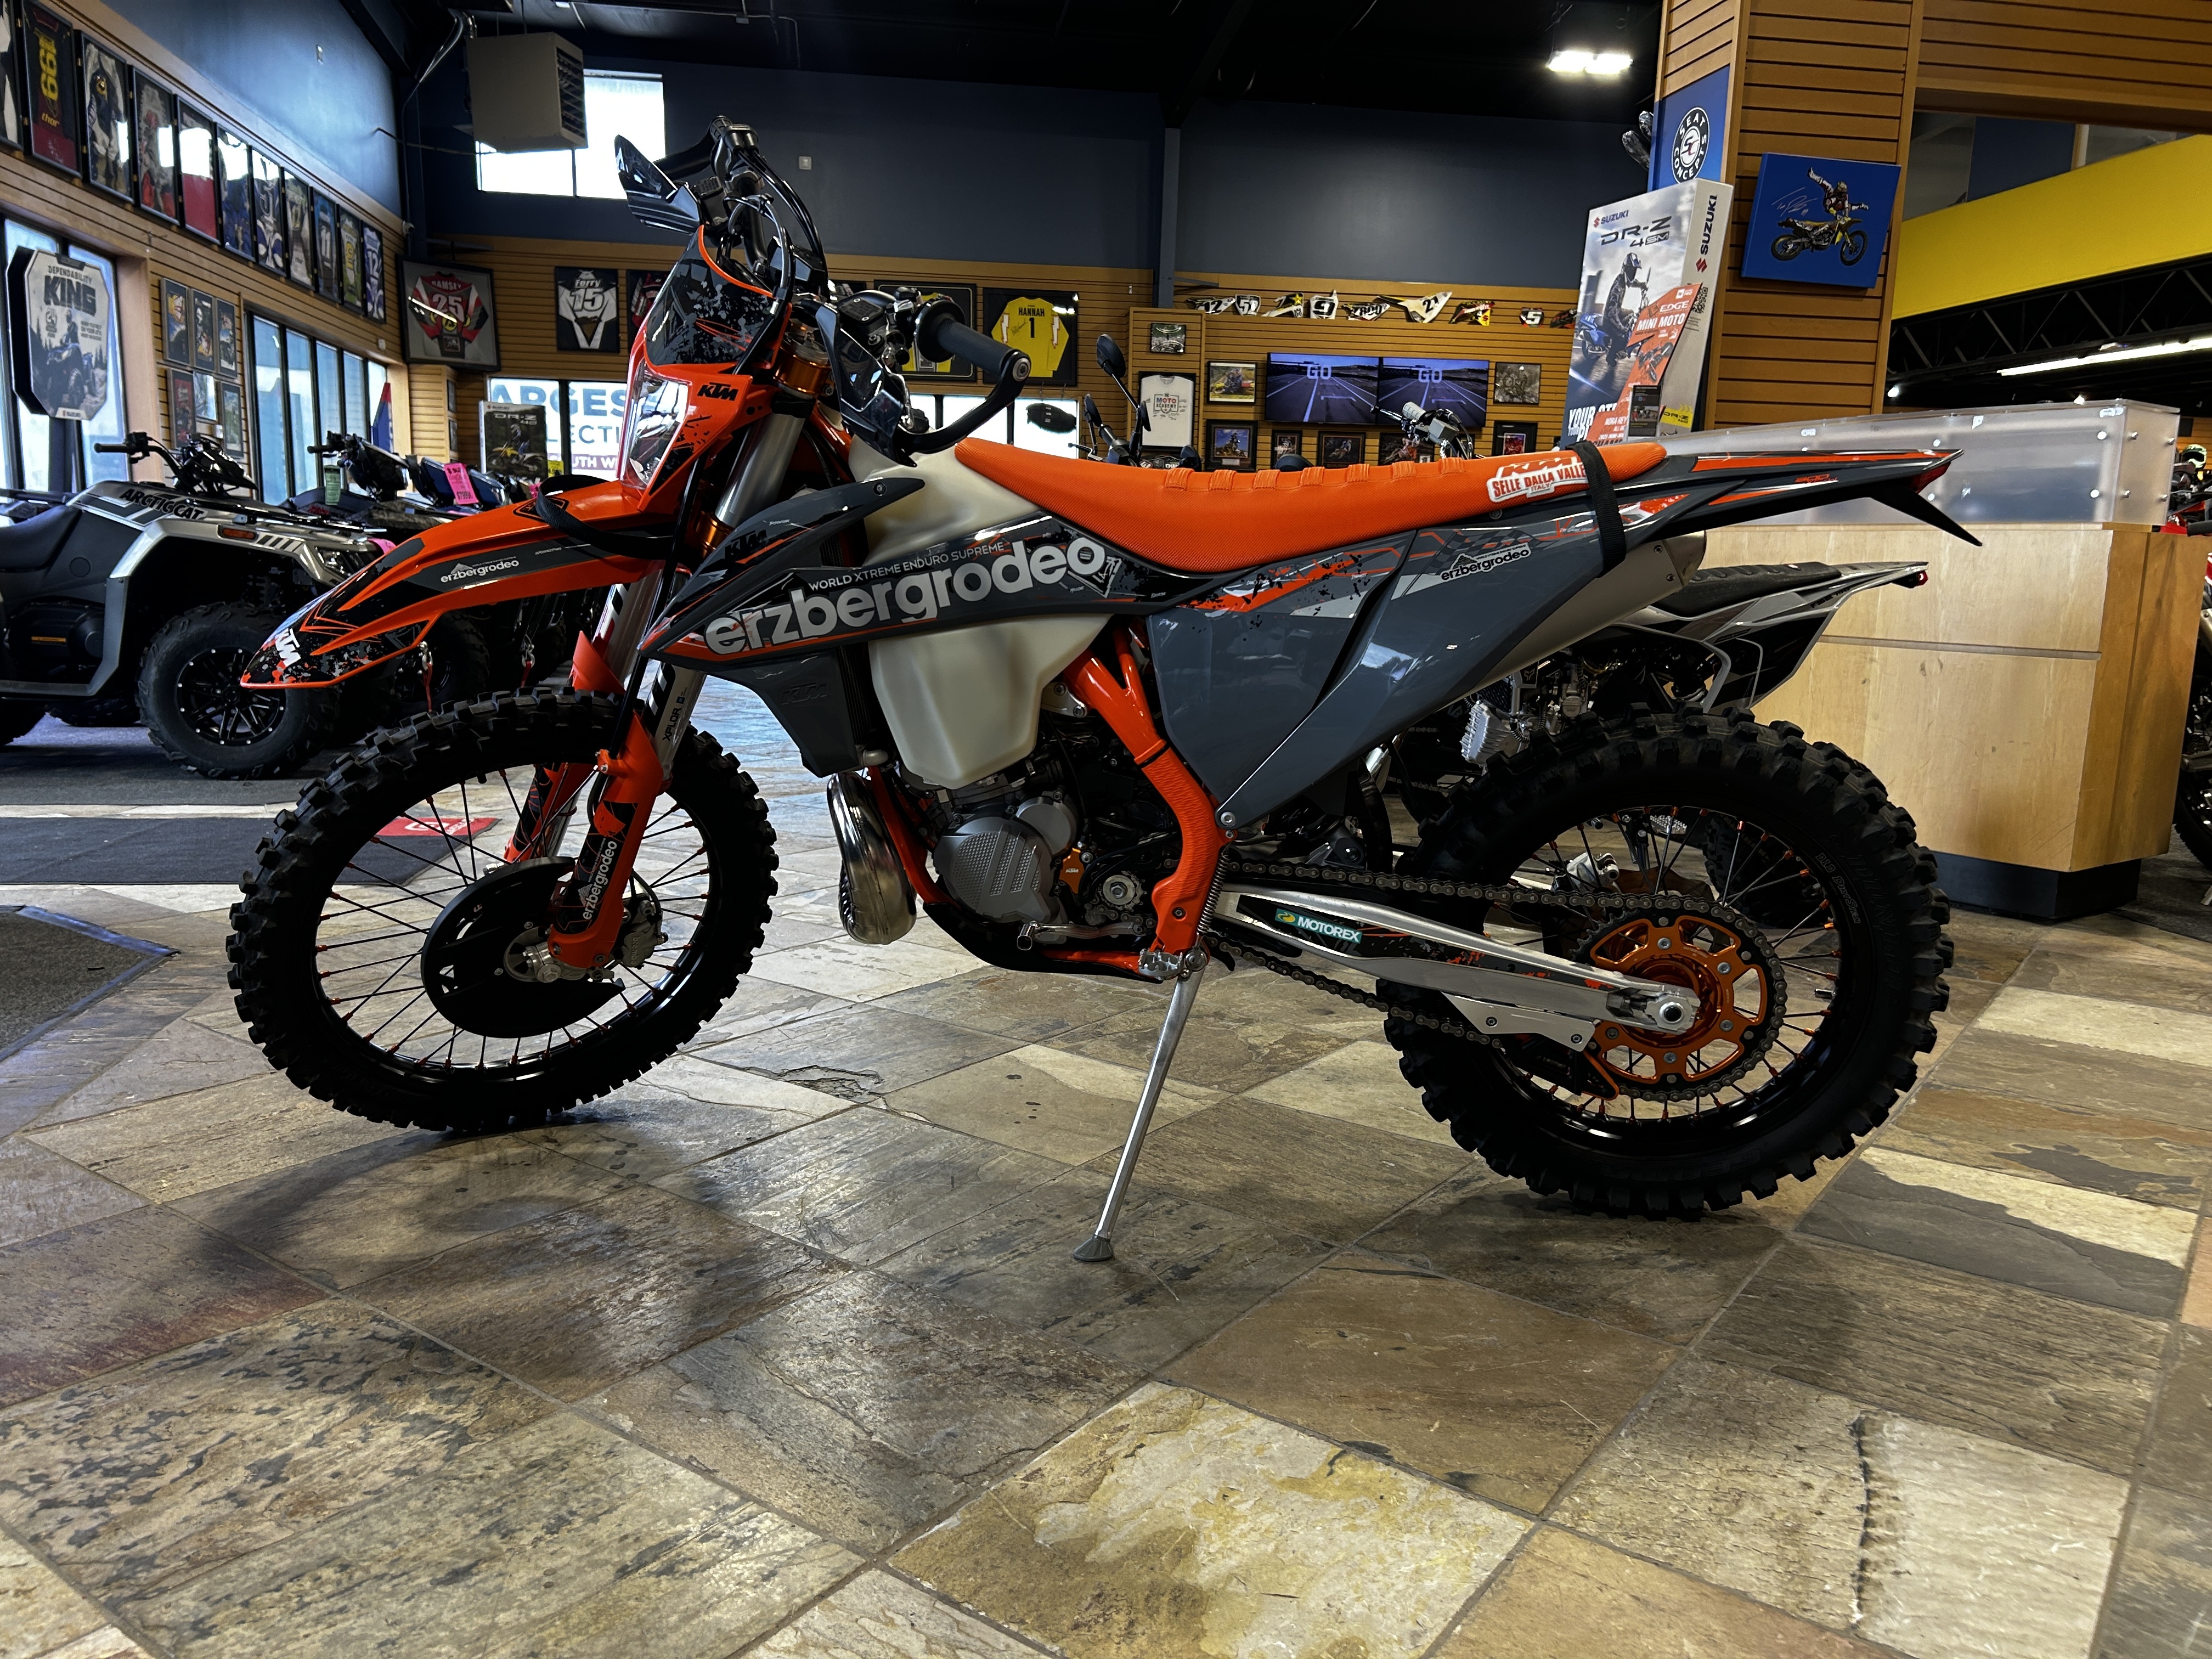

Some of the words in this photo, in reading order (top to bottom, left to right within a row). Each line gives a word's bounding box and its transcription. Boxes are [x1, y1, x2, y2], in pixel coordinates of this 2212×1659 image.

[42, 112, 59, 127] thor
[1680, 113, 1705, 139] SEAT
[1674, 134, 1707, 180] CONCEPTS
[1601, 210, 1629, 224] SUZUKI
[1701, 195, 1717, 255] SUZUKI
[1601, 216, 1672, 245] DR-Z
[48, 265, 92, 285] DEPENDABILITY
[44, 275, 96, 317] KING
[432, 294, 464, 323] 25
[570, 288, 605, 312] 15
[1660, 301, 1689, 312] EDGE
[1018, 307, 1045, 317] HANNAH
[1525, 312, 1542, 325] 5
[1637, 318, 1657, 331] MINI
[1658, 313, 1685, 328] MOTO
[1029, 317, 1035, 338] 1
[1307, 364, 1332, 380] GO
[1418, 368, 1443, 383] GO
[697, 382, 738, 401] KTM
[1568, 406, 1595, 429] YOUR
[1492, 478, 1521, 498] SELLE
[1524, 472, 1554, 487] DALLA
[1556, 464, 1587, 480] VALLE
[1531, 483, 1551, 492] ITALY
[120, 489, 174, 513] ARCTIC
[173, 504, 205, 520] CAT
[725, 530, 768, 560] KTM
[441, 560, 519, 583] erzbergrodeo
[808, 575, 852, 592] WORLD
[855, 565, 901, 582] XTREME
[904, 554, 949, 571] ENDURO
[952, 543, 1005, 561] SUPREME
[1441, 549, 1530, 580] erzbergrodeo
[705, 537, 1105, 654] erzbergrodeo
[781, 683, 827, 704] KTM
[662, 708, 681, 742] XPLOR
[583, 840, 617, 919] erzbergrodeo
[1297, 916, 1360, 943] MOTOREX
[631, 936, 640, 965] brembo
